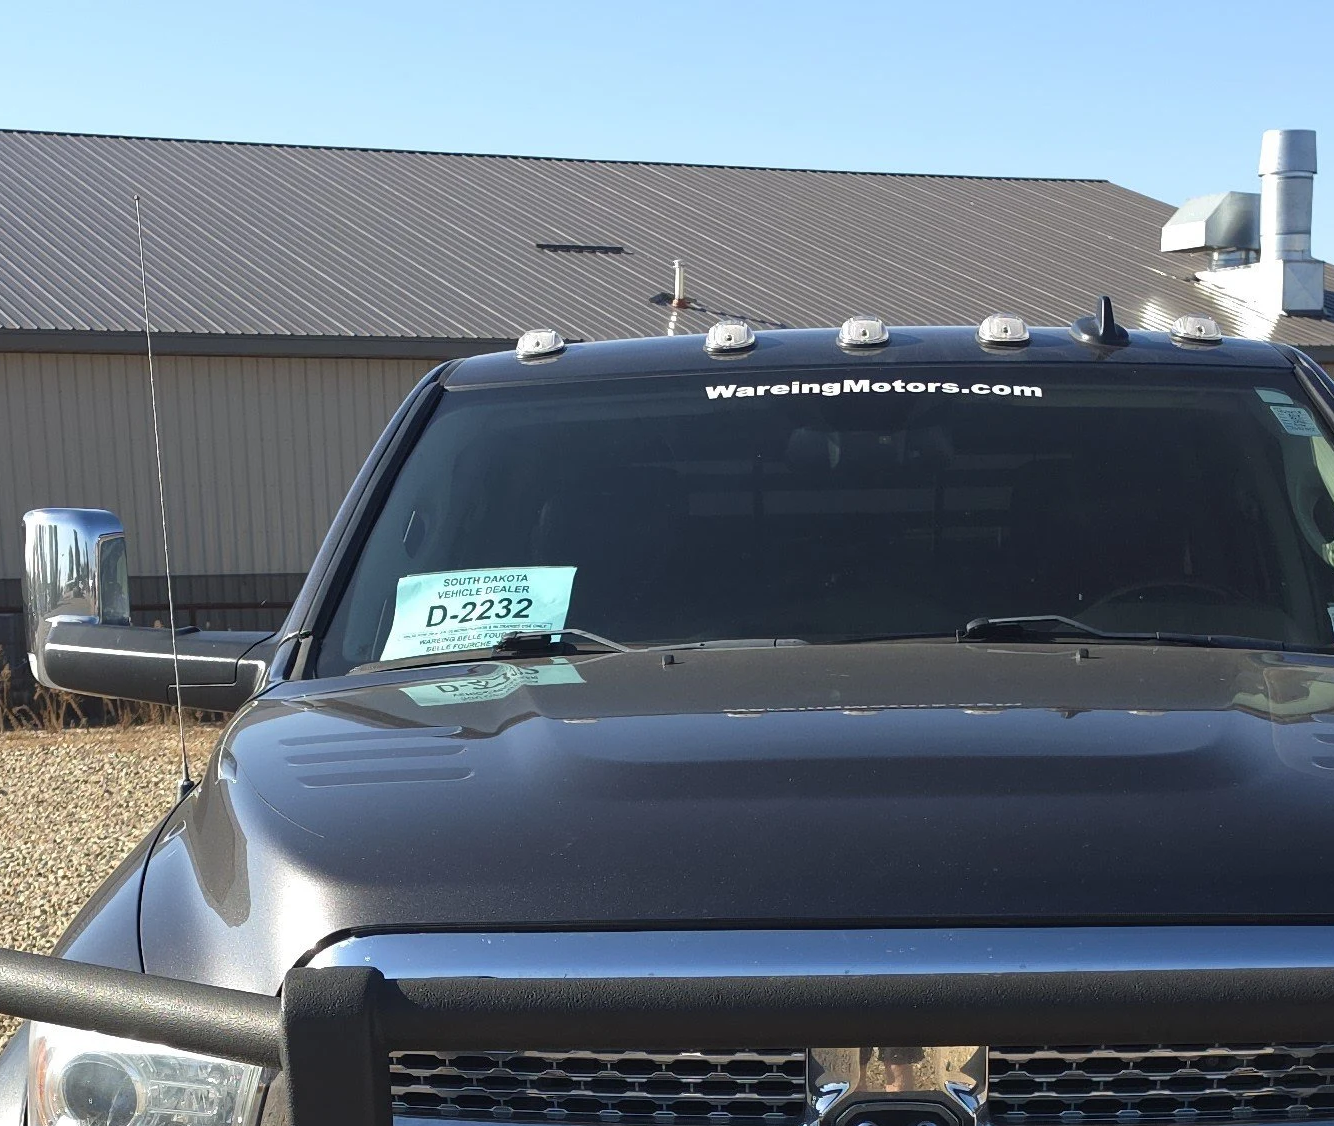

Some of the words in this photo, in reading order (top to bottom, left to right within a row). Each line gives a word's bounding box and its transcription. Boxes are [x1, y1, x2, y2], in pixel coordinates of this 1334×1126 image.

[705, 380, 1043, 400] WareingMotors.com
[443, 576, 481, 587] SOUTH
[483, 574, 529, 583] DAKOTA
[437, 587, 483, 599] VEHICLE
[485, 585, 530, 595] DEALER
[426, 597, 533, 627] D-2232
